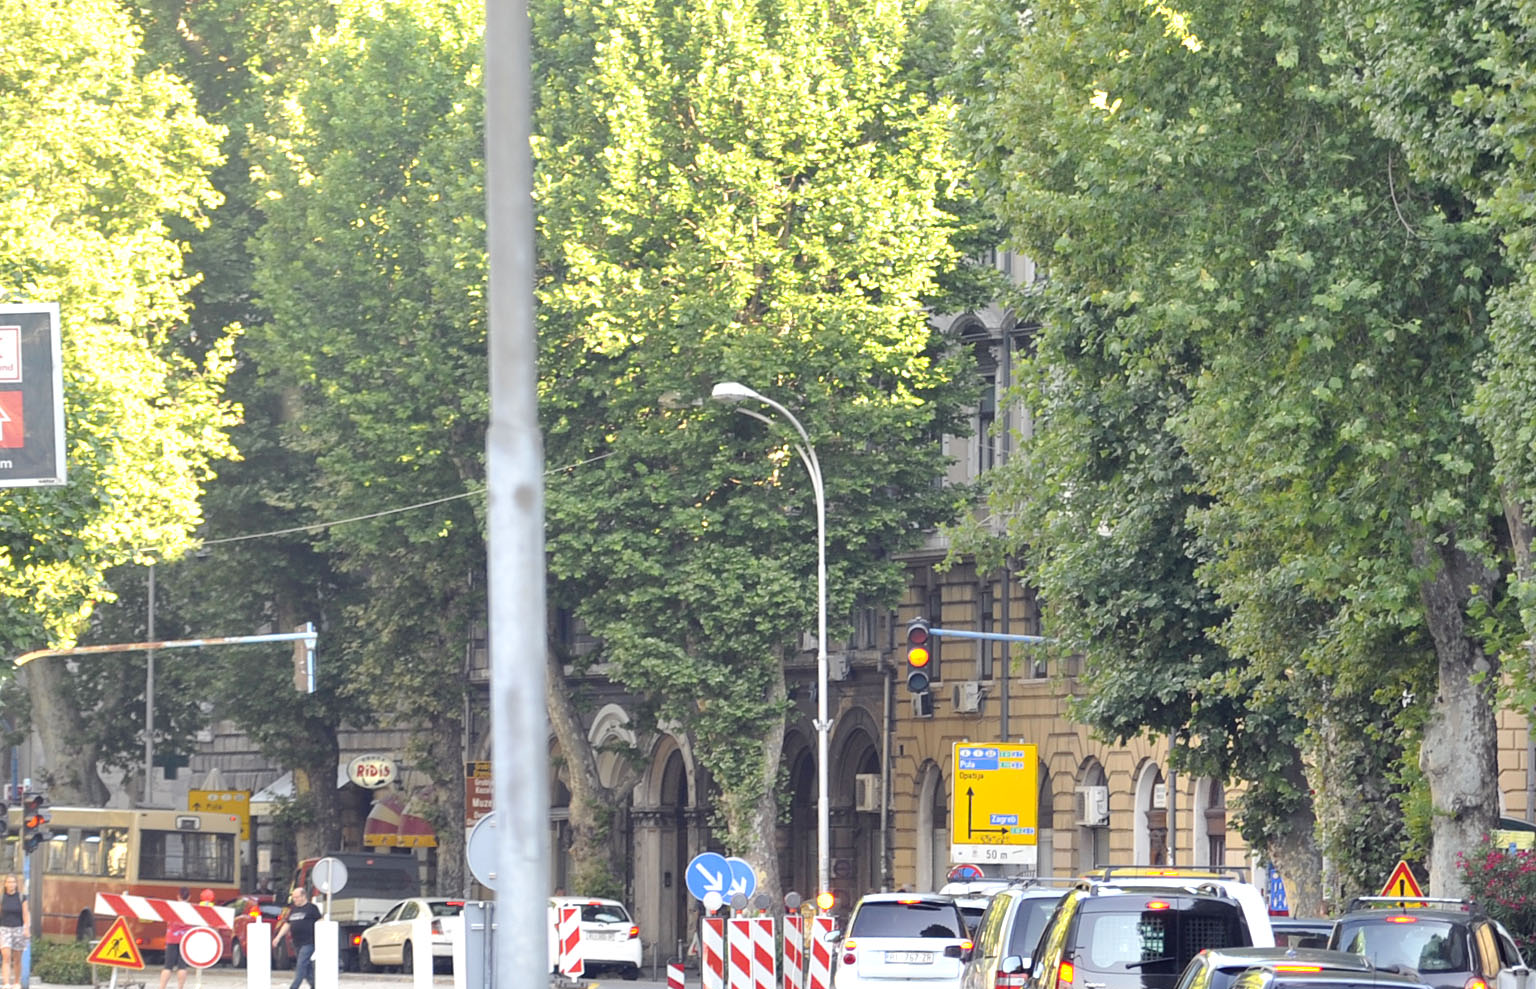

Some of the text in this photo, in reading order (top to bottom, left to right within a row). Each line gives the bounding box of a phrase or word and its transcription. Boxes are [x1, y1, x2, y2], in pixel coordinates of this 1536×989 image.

[960, 760, 976, 769] Pula
[959, 771, 984, 781] Opatija
[991, 814, 1018, 826] Zagreb
[986, 849, 1008, 860] 50 m
